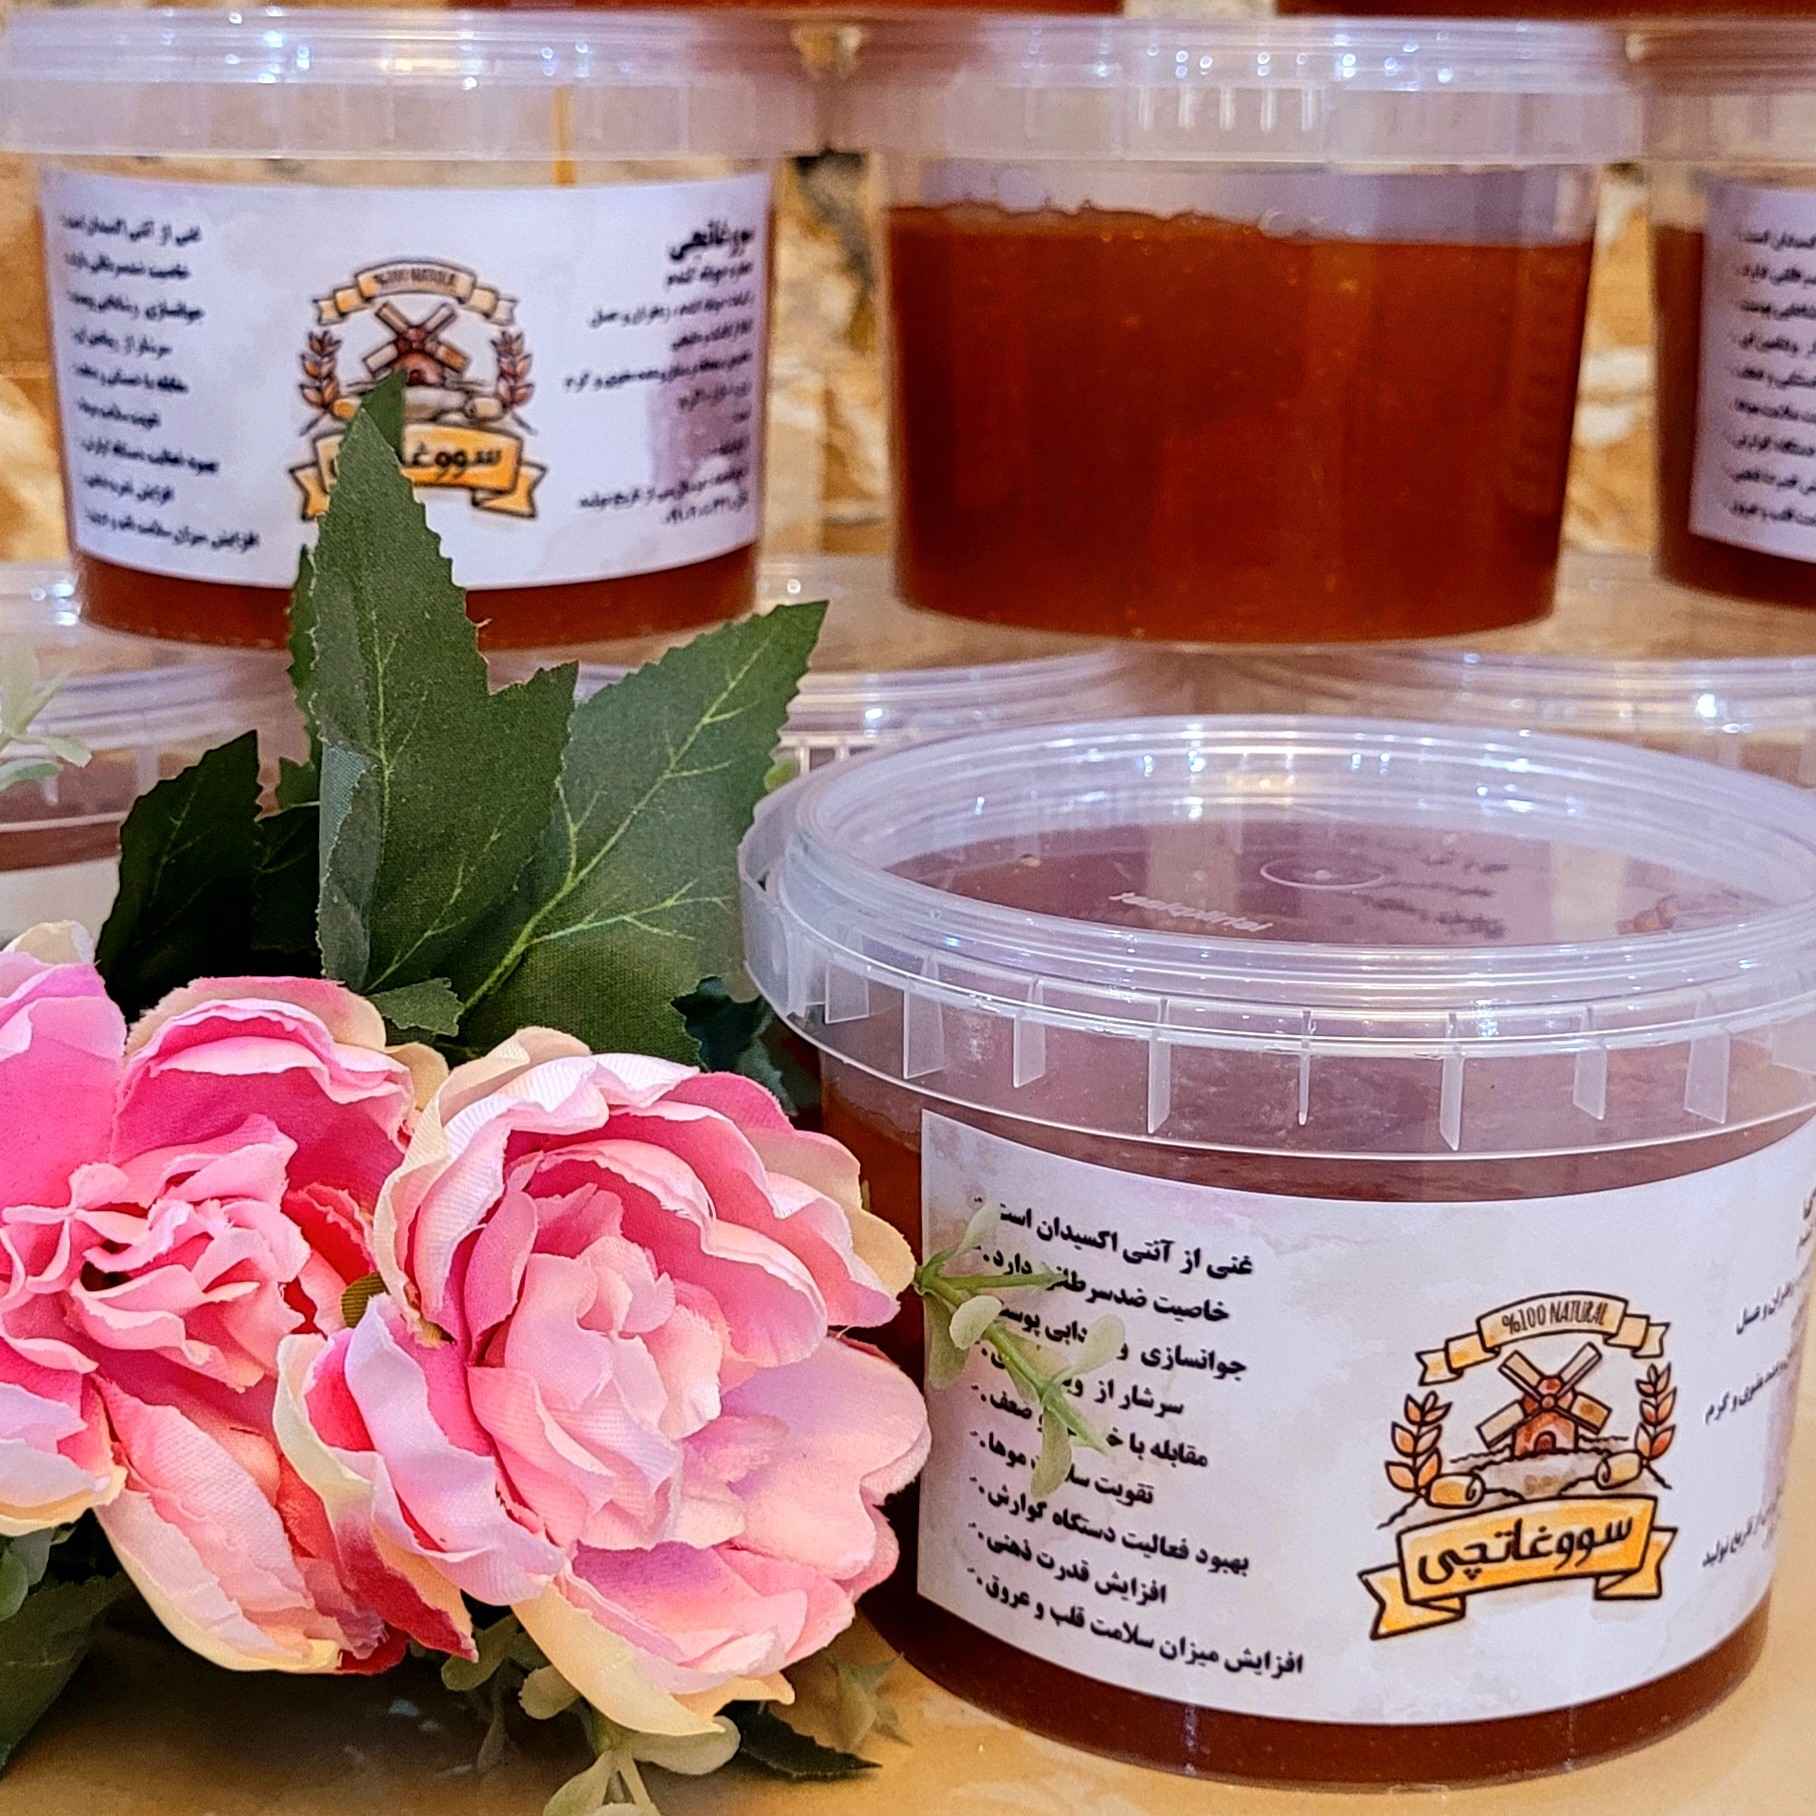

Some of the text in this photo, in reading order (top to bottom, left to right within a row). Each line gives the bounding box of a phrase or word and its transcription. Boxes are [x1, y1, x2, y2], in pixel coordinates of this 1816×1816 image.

[1037, 1217, 1118, 1252] اکسیدان
[1123, 1239, 1175, 1264] آنتی
[1180, 1247, 1201, 1274] از
[1206, 1255, 1253, 1279] غنی
[1152, 1297, 1230, 1323] خاصیت
[1502, 1299, 1610, 1335] %100 NATURAL
[1140, 1344, 1247, 1381] جوانسازی
[1094, 1378, 1114, 1403] از
[1118, 1384, 1184, 1418] سرشار
[1129, 1432, 1146, 1460] با
[1150, 1440, 1208, 1468] مقابله
[1095, 1476, 1155, 1507] تقویت
[1052, 1508, 1116, 1543] دستگاه
[1122, 1531, 1190, 1560] فعالیت
[1417, 1516, 1634, 1586] سووغاتچی
[1036, 1552, 1090, 1582] قدرت
[1195, 1548, 1250, 1577] بهبود
[1094, 1571, 1167, 1606] افزایش
[1034, 1601, 1045, 1620] و
[1050, 1604, 1086, 1629] قلب
[1090, 1619, 1154, 1650] سلامت
[1159, 1636, 1220, 1666] میزان
[1223, 1648, 1305, 1679] افزایش
